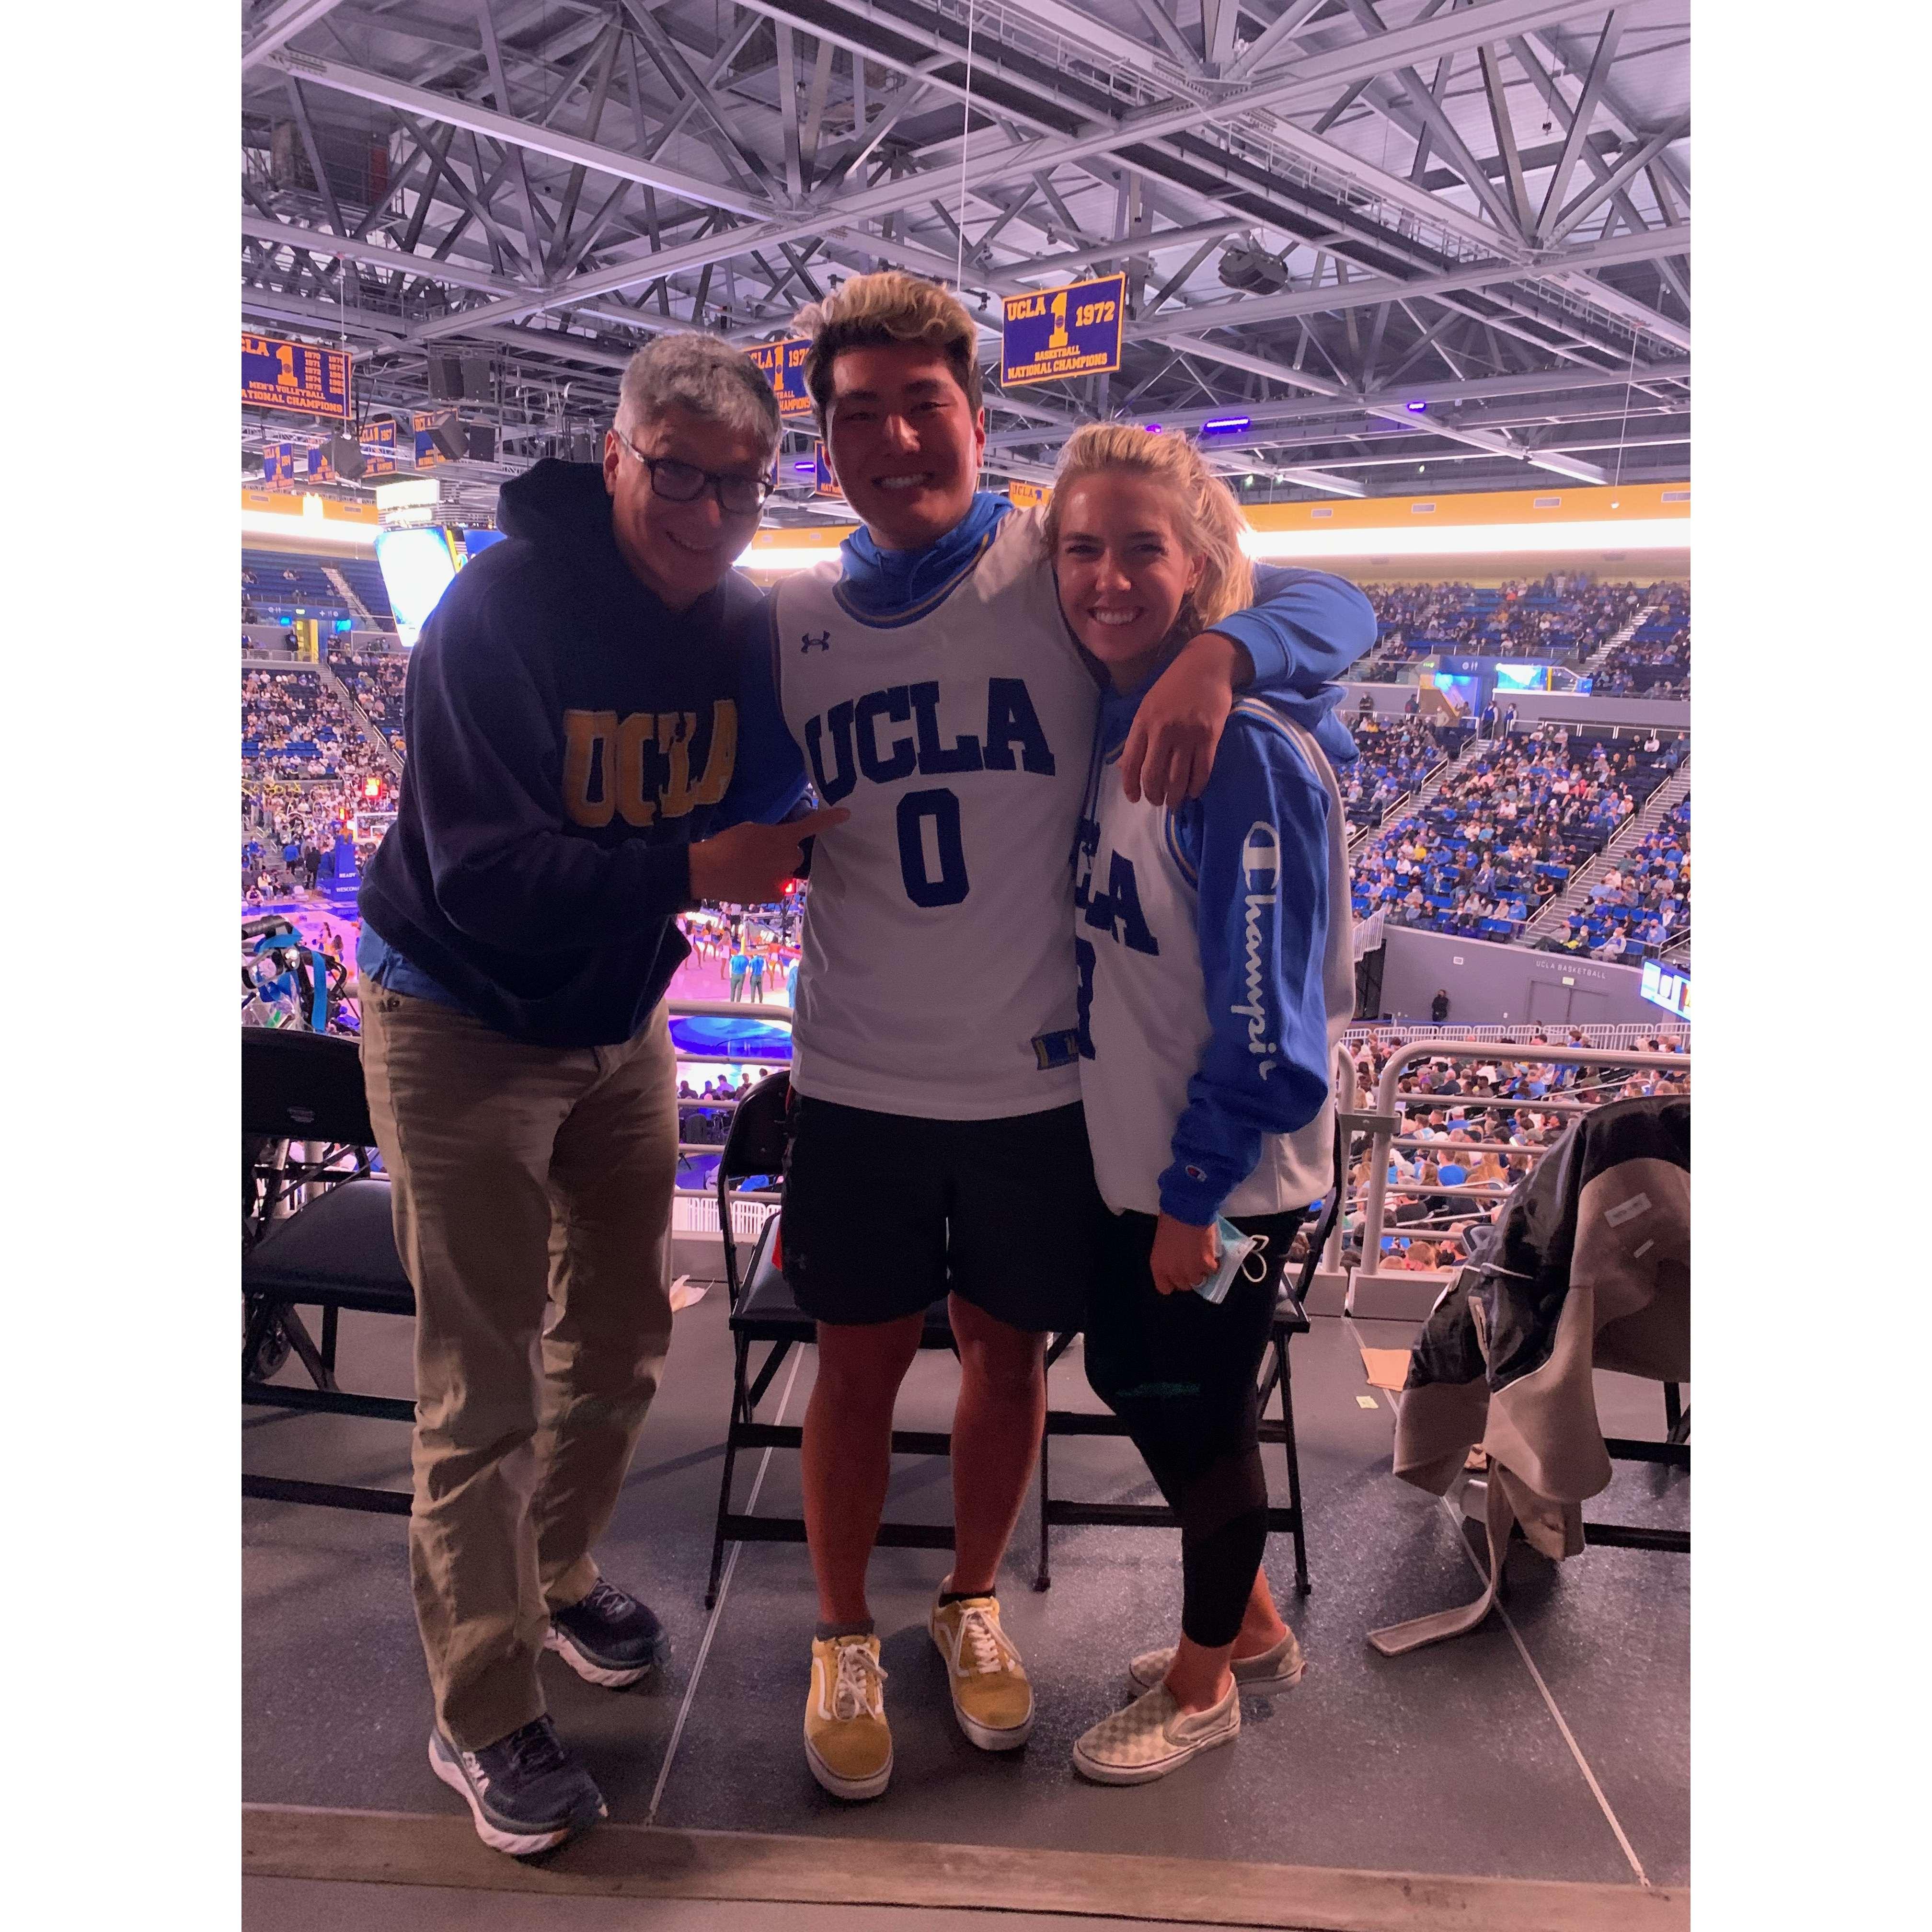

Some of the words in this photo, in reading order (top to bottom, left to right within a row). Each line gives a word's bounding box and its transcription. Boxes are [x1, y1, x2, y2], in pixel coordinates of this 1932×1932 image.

[1007, 297, 1046, 322] UCLA
[1049, 292, 1069, 349] 1
[1075, 301, 1116, 327] 1972
[276, 345, 298, 387] 1
[1008, 361, 1052, 379] NATIONAL
[1053, 353, 1107, 372] CHAMPIONS
[1035, 345, 1081, 361] BASKETBALL
[773, 345, 784, 391] 1
[249, 380, 274, 391] MEN'S
[276, 385, 326, 400] VOLLEYBALL
[287, 396, 343, 413] CHAMPIONS
[1012, 484, 1034, 498] UCLA
[805, 677, 1055, 806] UCLA
[896, 787, 970, 908] 0
[1536, 960, 1555, 969] UCLA
[1558, 965, 1606, 978] BASKETBALL
